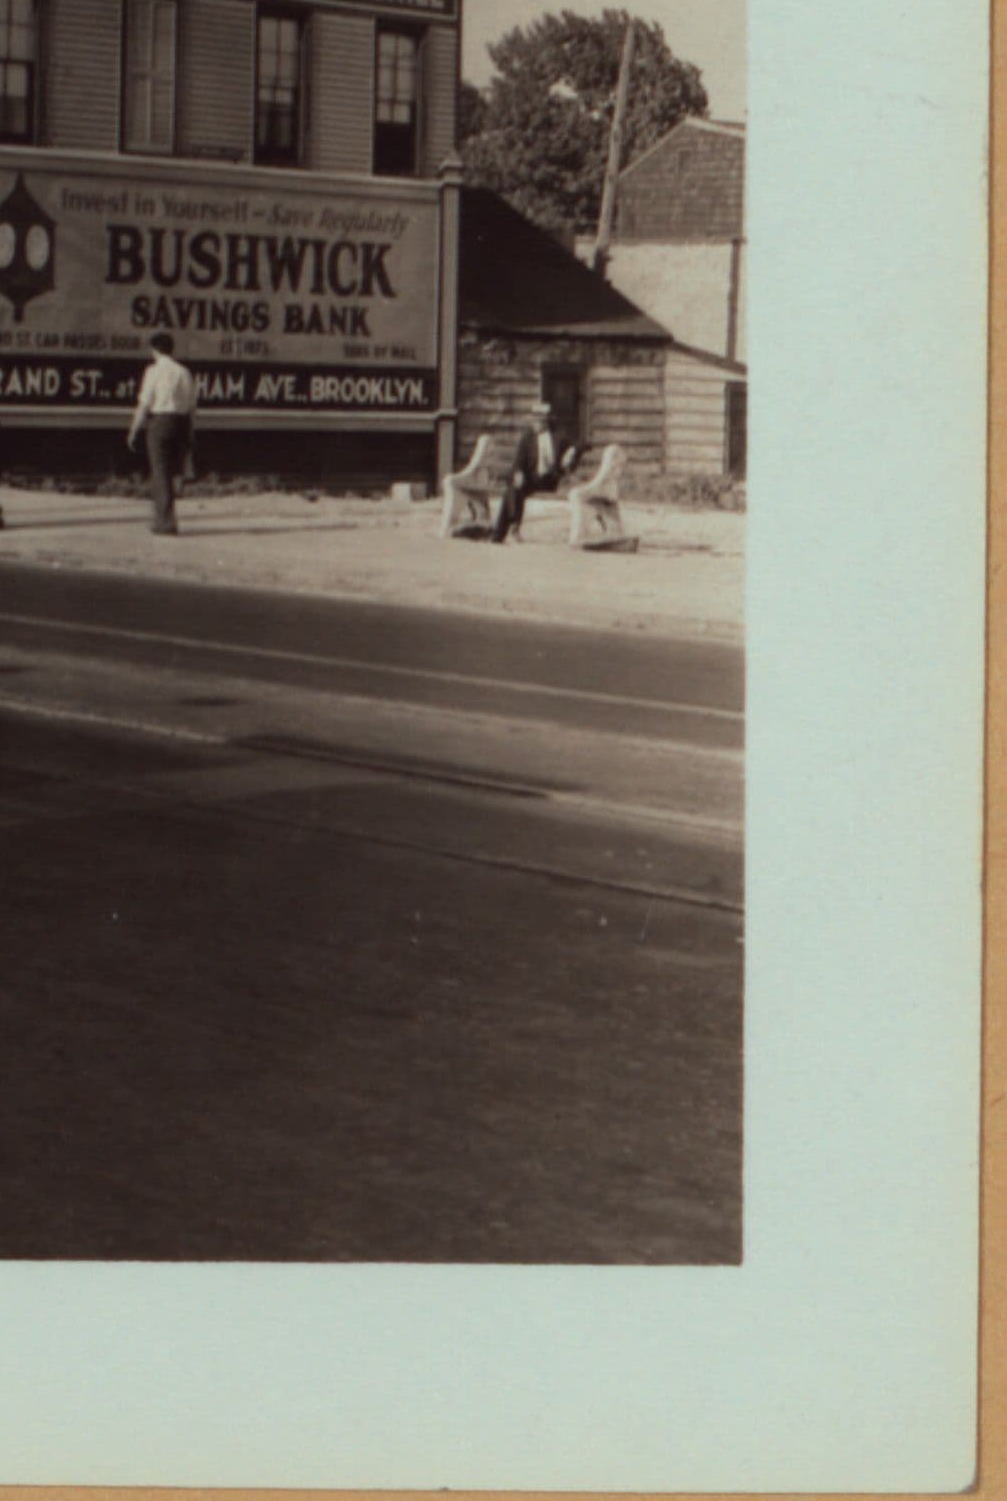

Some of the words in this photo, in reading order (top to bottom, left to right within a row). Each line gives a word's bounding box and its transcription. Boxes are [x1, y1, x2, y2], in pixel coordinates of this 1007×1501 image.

[61, 187, 129, 215] Invest
[134, 189, 156, 217] in
[162, 192, 249, 223] Yourself
[268, 203, 315, 228] Save
[319, 206, 410, 241] Regularly
[105, 225, 396, 298] BUSHWICK
[132, 295, 270, 333] SAVINGS
[284, 305, 371, 337] BANK
[116, 377, 136, 400] at
[193, 372, 246, 401] HAM
